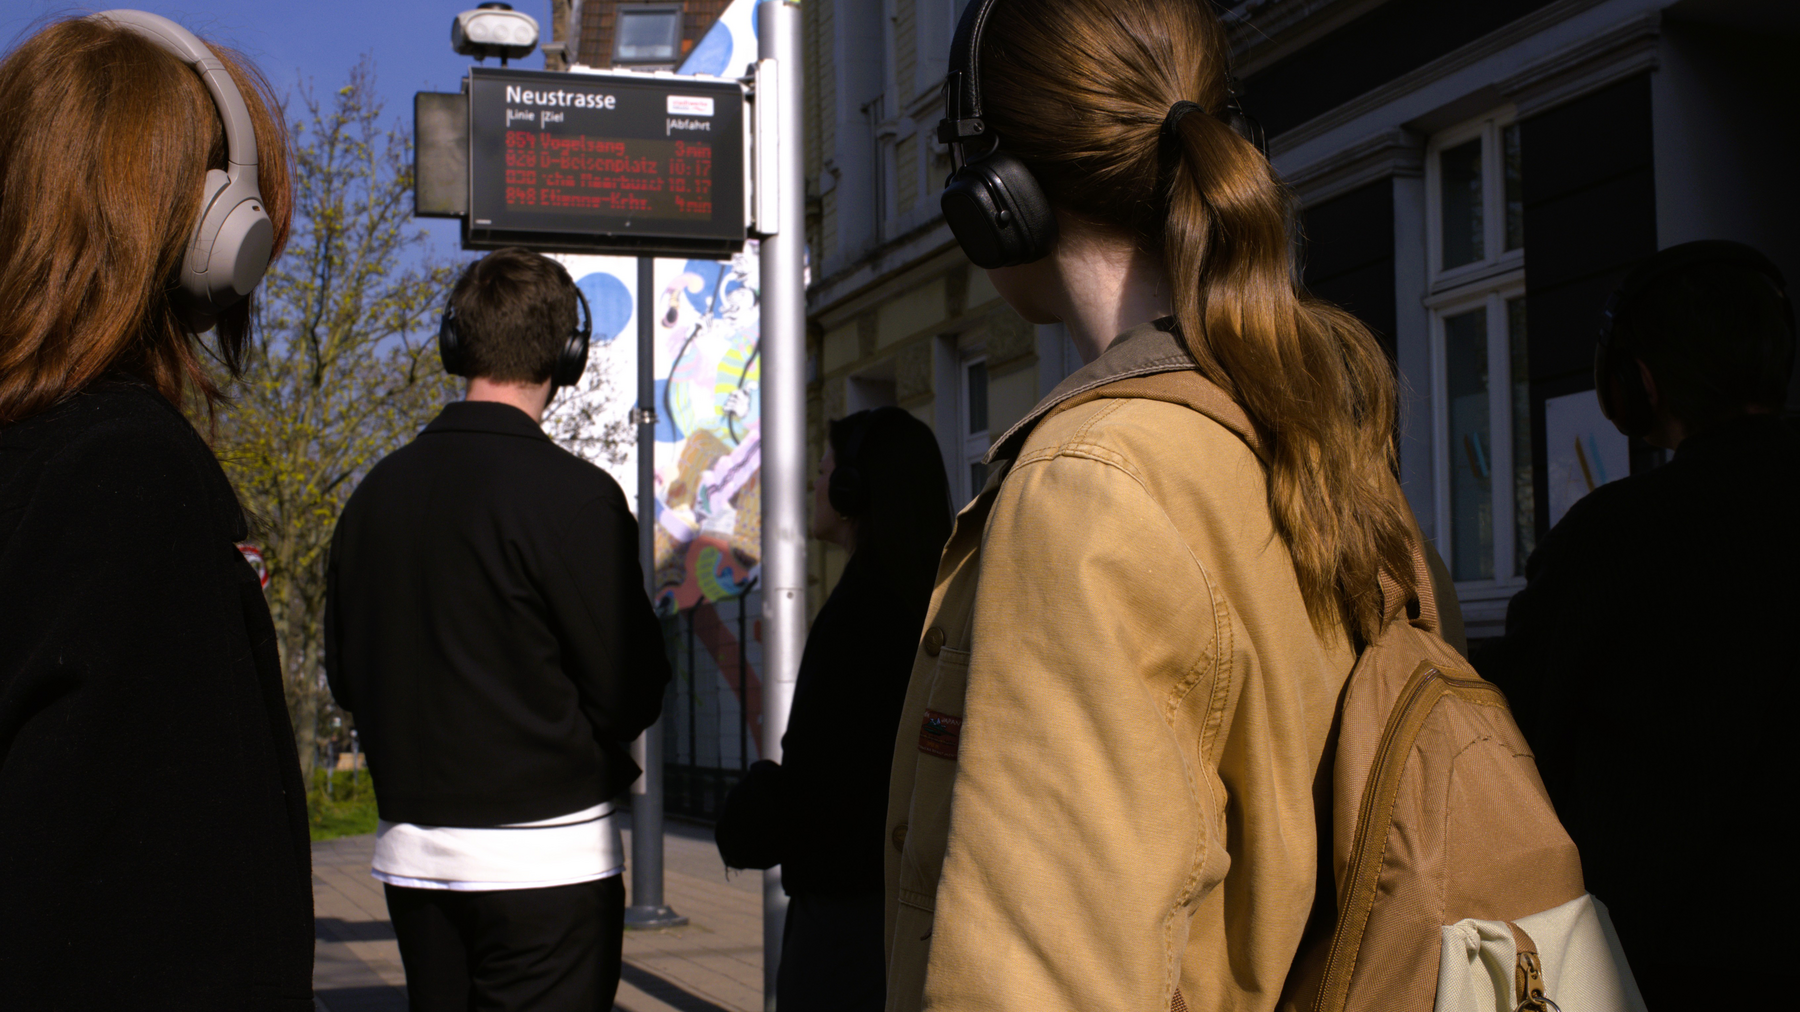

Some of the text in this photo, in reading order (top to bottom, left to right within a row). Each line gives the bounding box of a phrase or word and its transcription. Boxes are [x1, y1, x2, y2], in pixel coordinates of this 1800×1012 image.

[506, 85, 616, 109] Neustrasse
[510, 109, 711, 131] Linie Ziel Abfahrt
[505, 130, 536, 149] 854
[540, 132, 625, 156] Vogelsang
[669, 158, 712, 177] 10:17
[505, 186, 537, 205] 848
